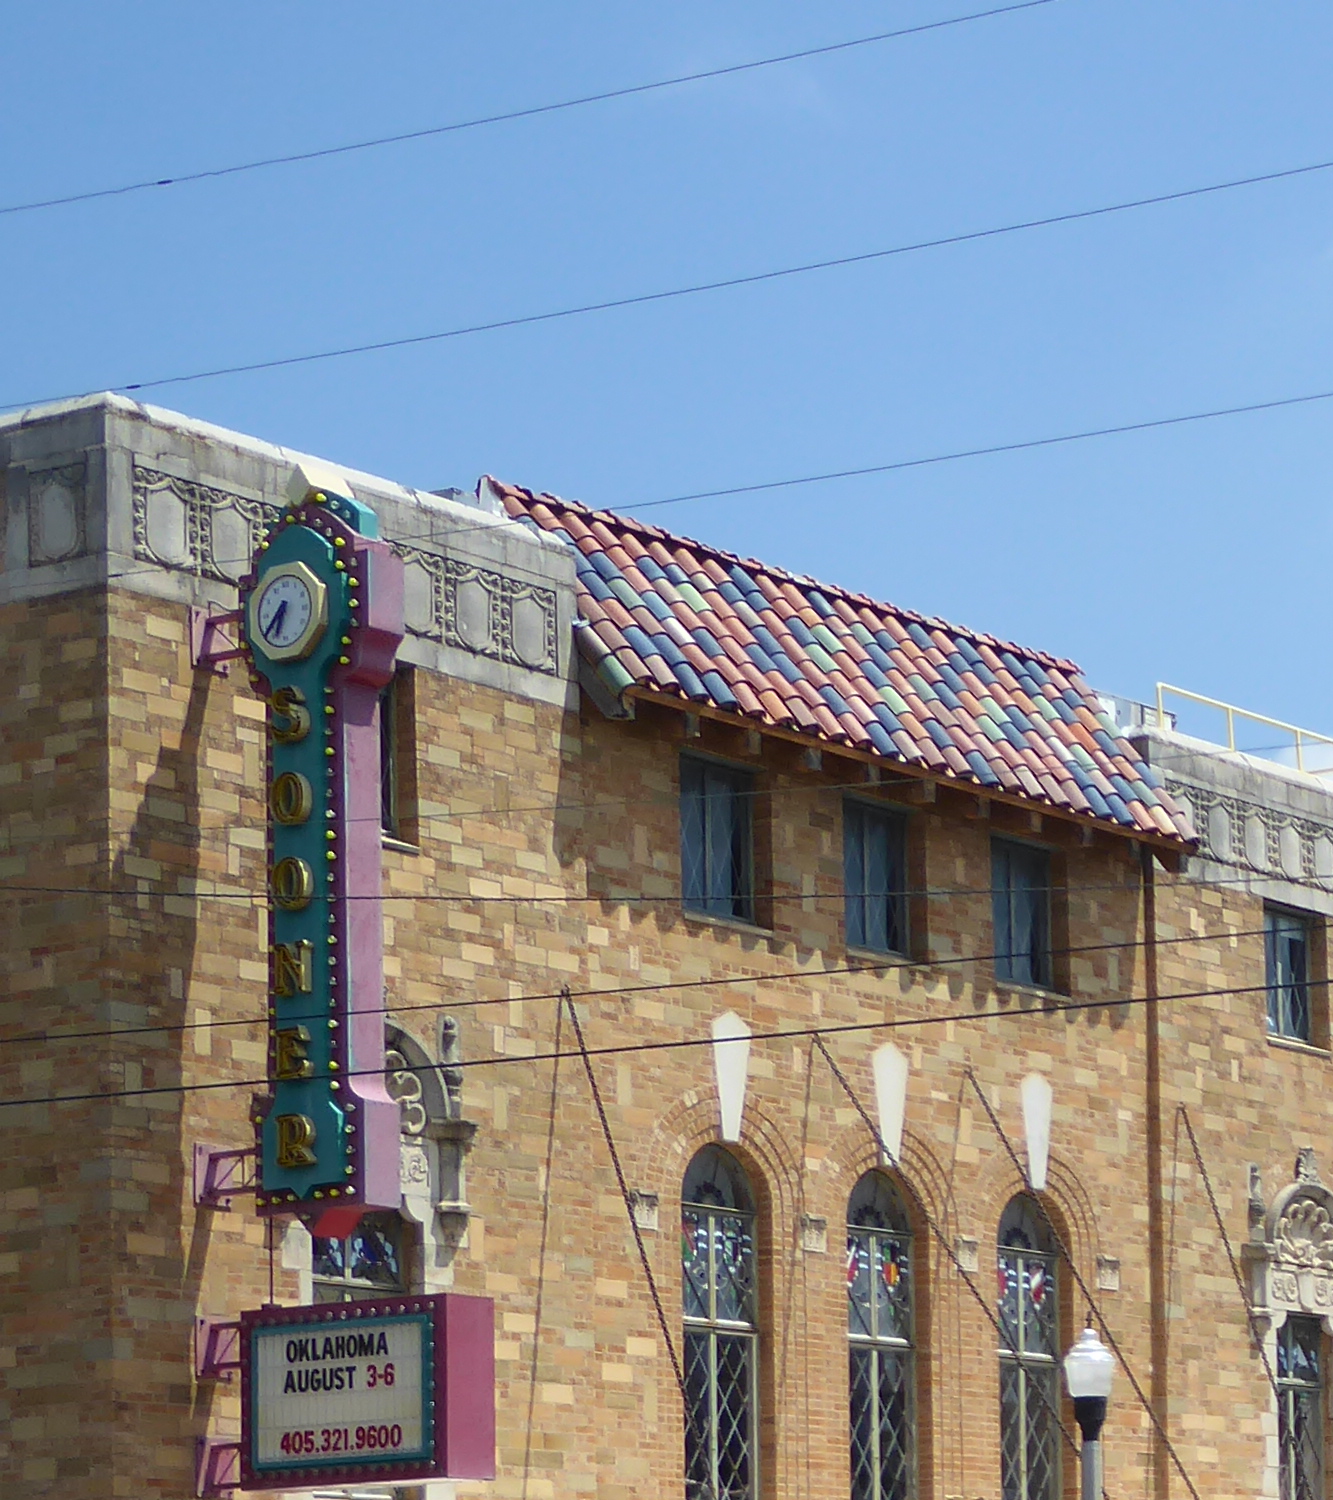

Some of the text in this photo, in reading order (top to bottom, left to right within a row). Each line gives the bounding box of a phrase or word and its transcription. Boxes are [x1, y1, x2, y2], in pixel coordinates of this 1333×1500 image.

[271, 684, 318, 1168] SOONER
[286, 1332, 389, 1363] OKLAHOMA
[284, 1363, 395, 1394] AUGUST 3-6
[280, 1424, 402, 1455] 405.321.9600
